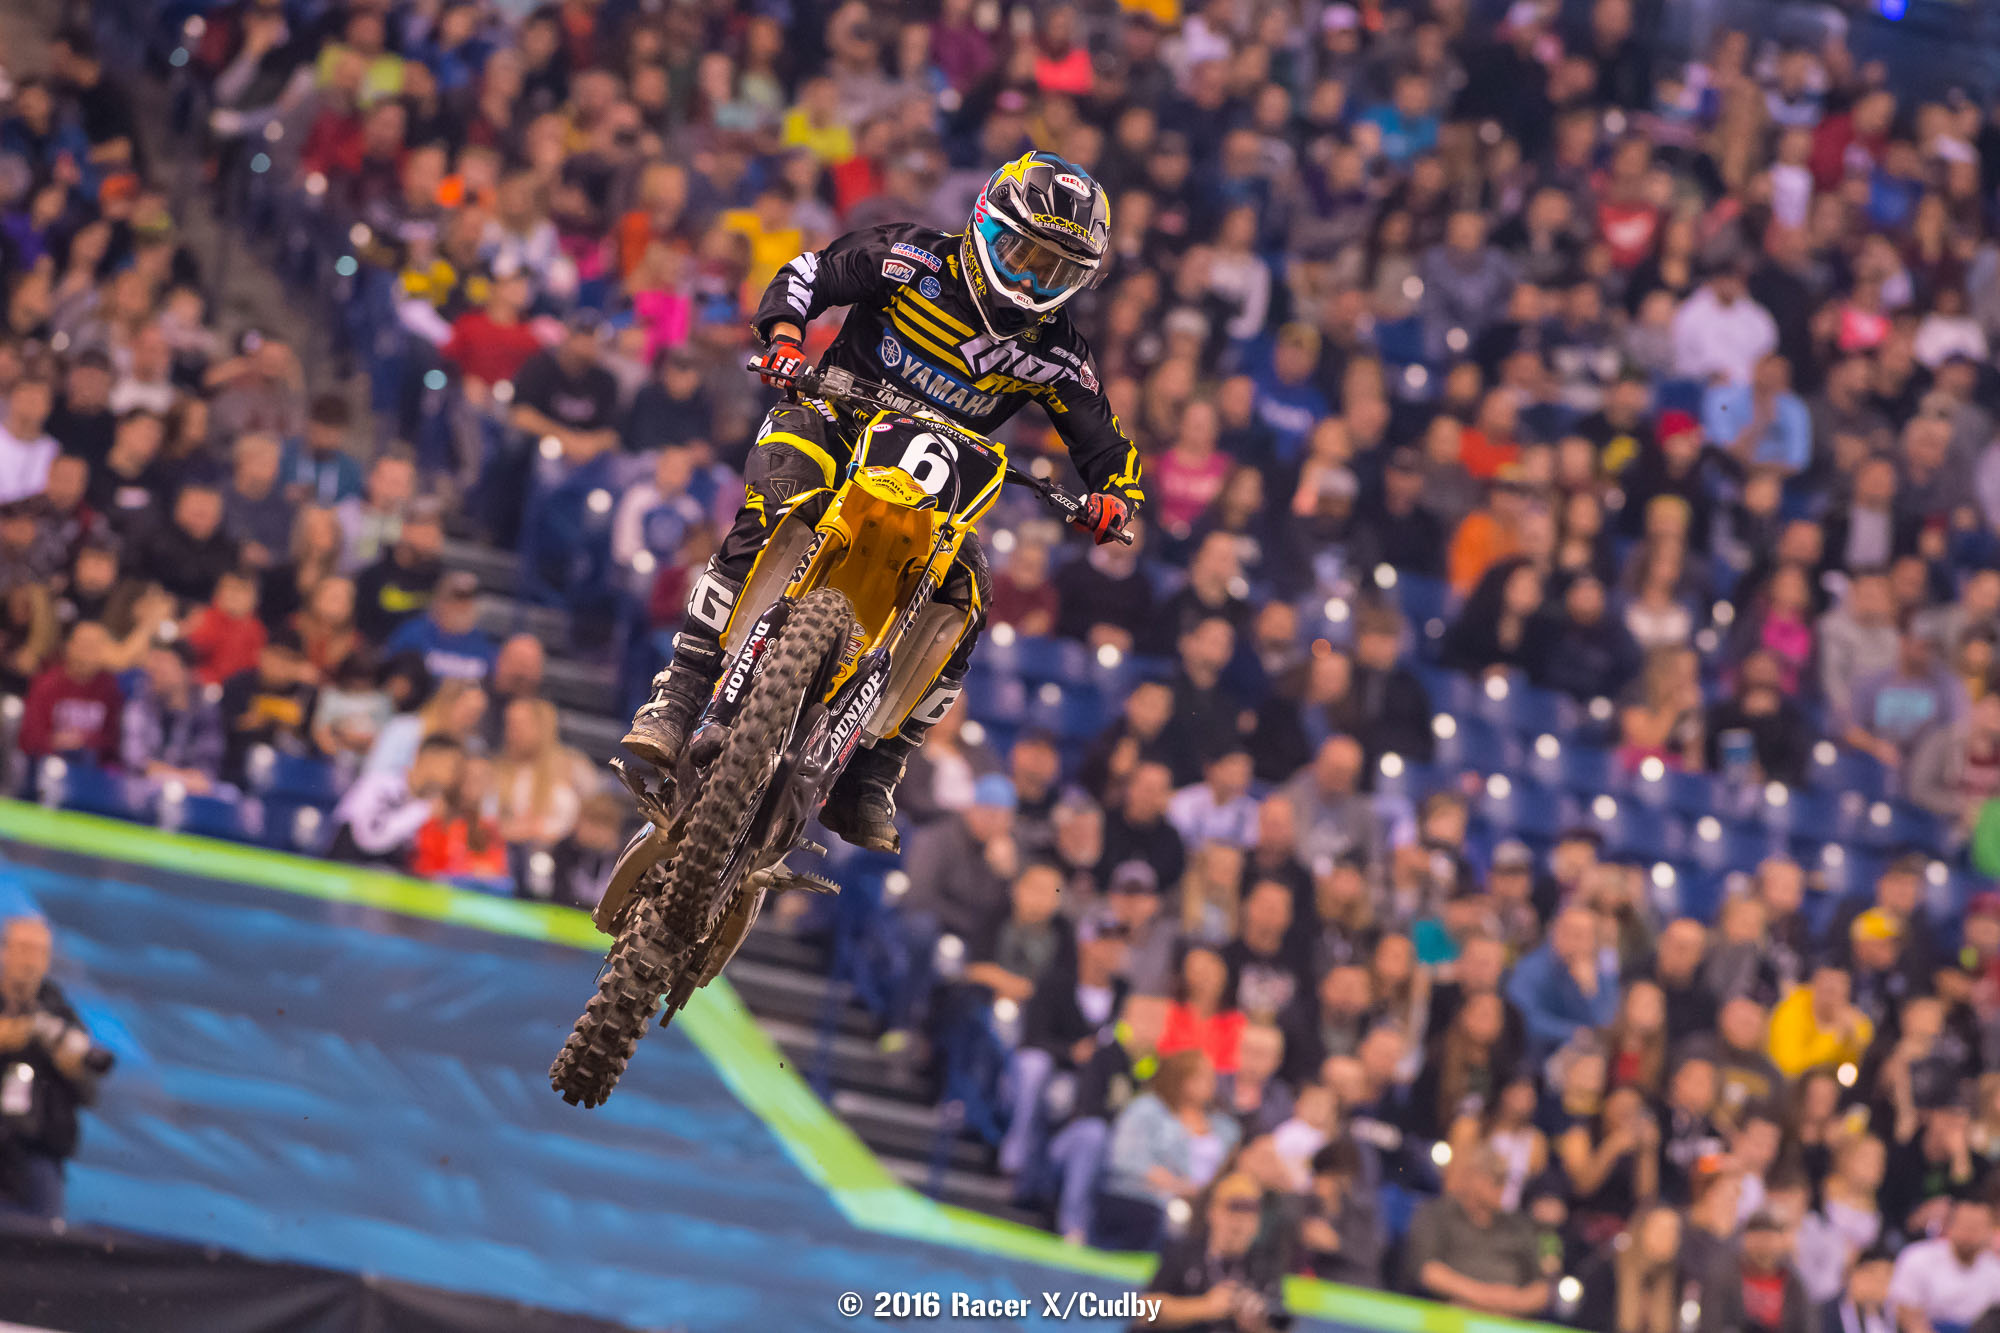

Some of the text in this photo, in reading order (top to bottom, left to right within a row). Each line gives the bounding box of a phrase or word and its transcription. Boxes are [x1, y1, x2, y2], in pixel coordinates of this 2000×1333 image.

[1061, 176, 1086, 193] BELL
[885, 263, 912, 280] 100%
[900, 354, 999, 416] YAMAHA
[897, 432, 959, 495] 6
[871, 478, 905, 496] YAMAHA
[1050, 493, 1079, 512] ARC
[724, 619, 771, 704] DUNLOP
[830, 670, 882, 754] DUNLOP
